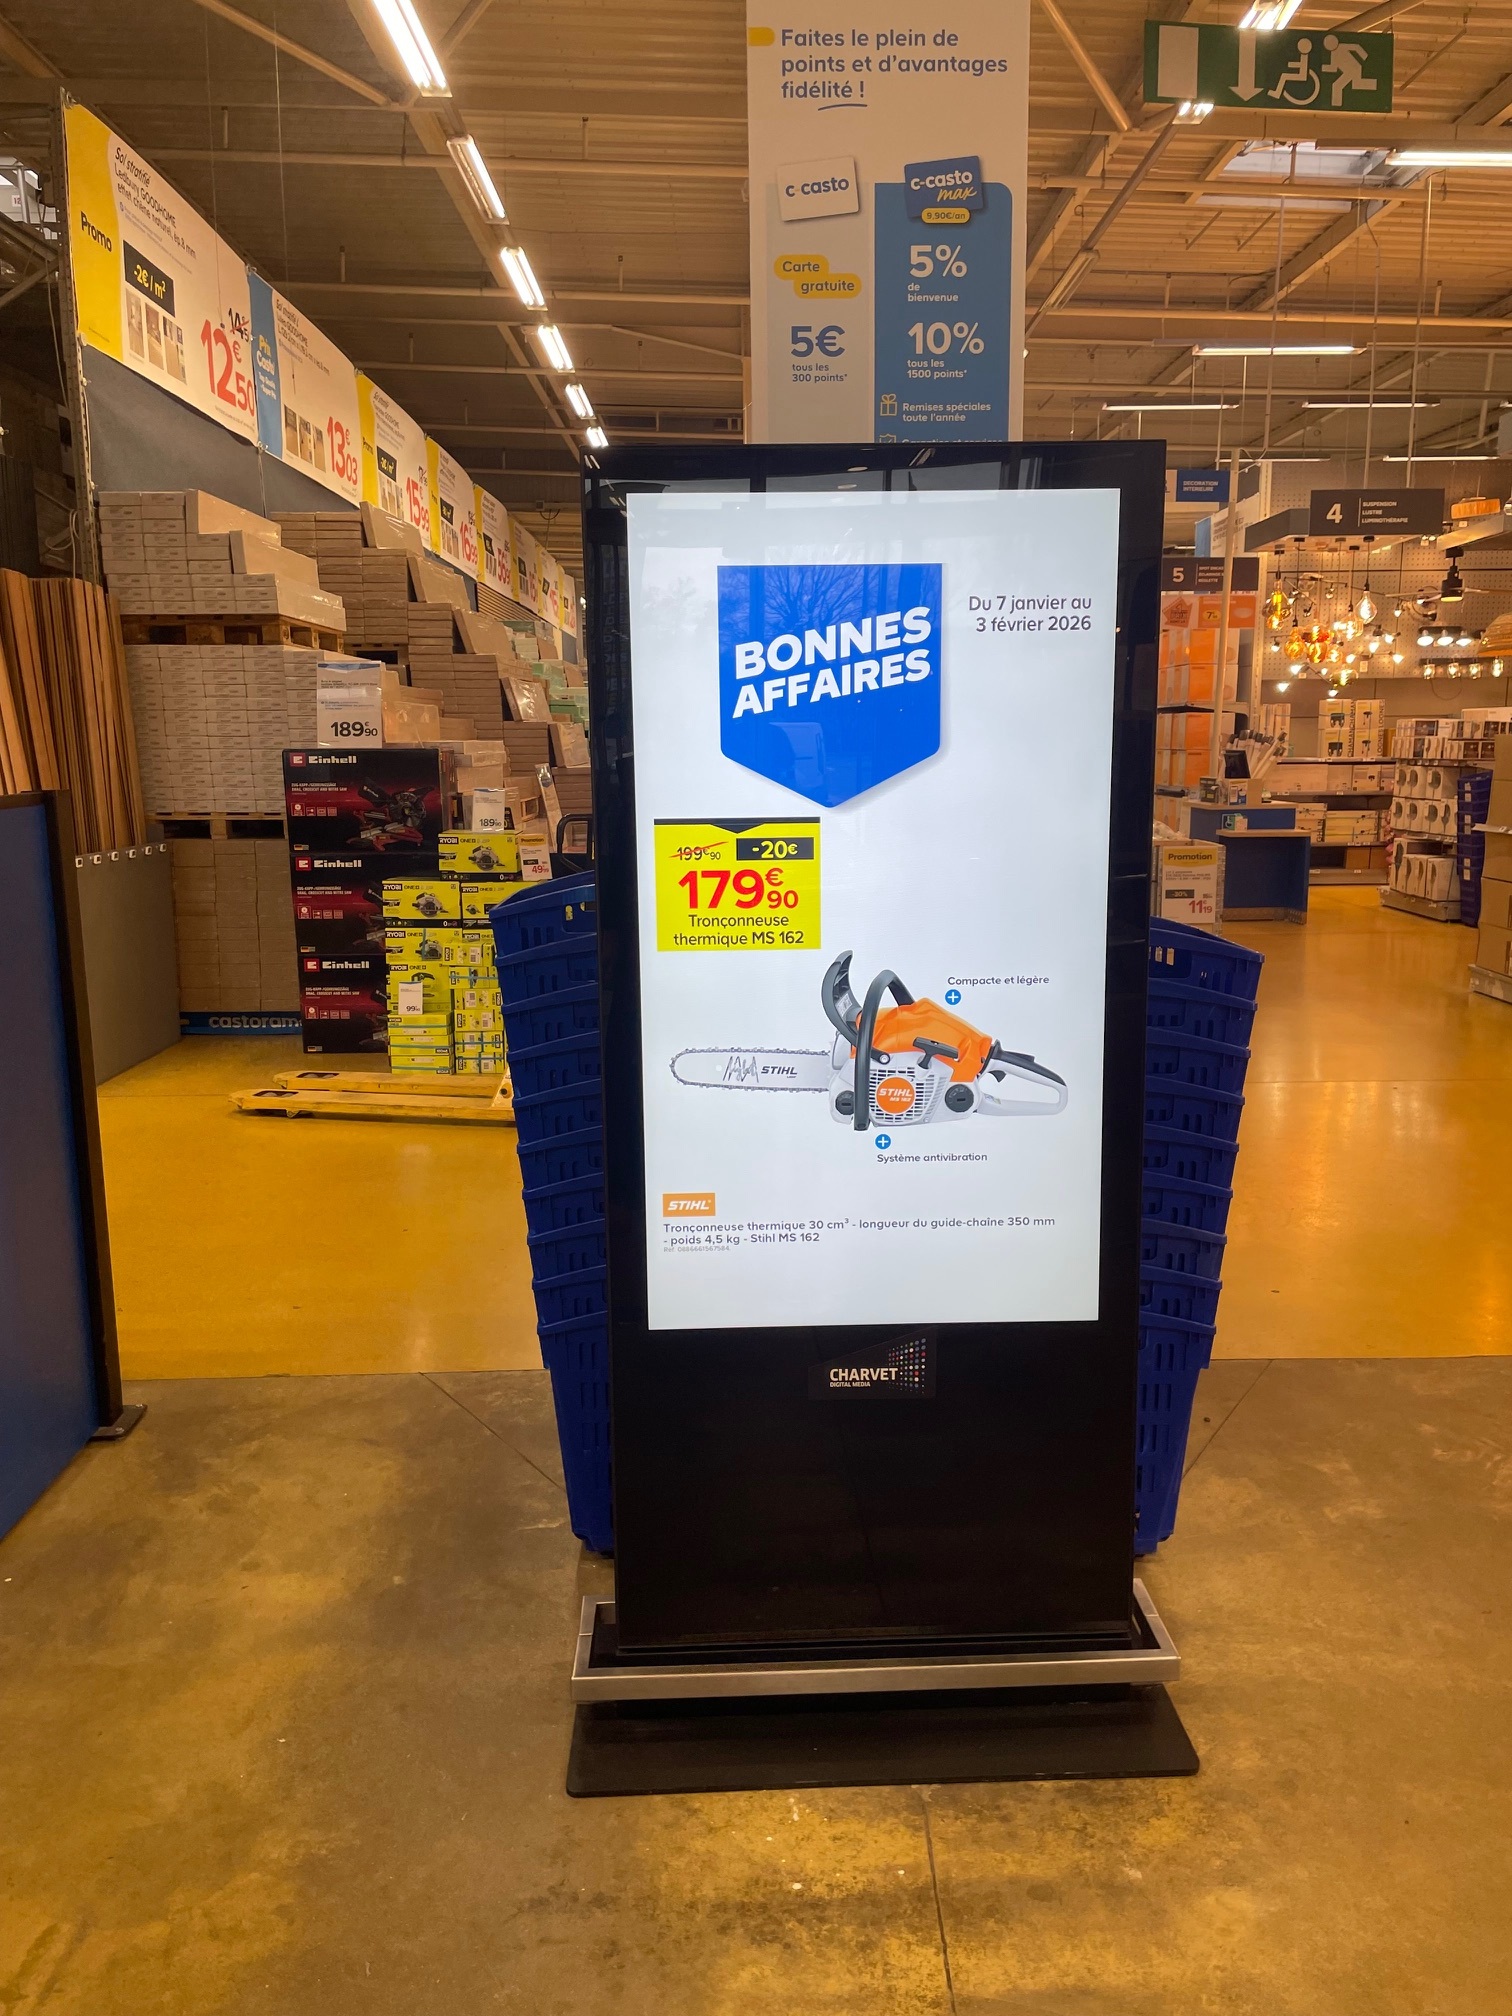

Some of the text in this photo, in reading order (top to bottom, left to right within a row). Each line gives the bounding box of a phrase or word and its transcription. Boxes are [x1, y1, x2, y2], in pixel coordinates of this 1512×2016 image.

[781, 29, 959, 51] Faites le plein de
[781, 55, 846, 77] points
[852, 56, 872, 73] et
[781, 80, 865, 98] fidélité !
[115, 147, 127, 164] Sol
[126, 159, 151, 188] stratifié
[910, 170, 973, 191] c-casto
[117, 182, 133, 202] effet
[133, 195, 151, 219] chêne
[936, 186, 978, 202] max
[140, 187, 177, 229] GOODHOME
[926, 212, 966, 221] 9,90€/an
[80, 211, 112, 252] Promo
[782, 261, 820, 273] Carte
[909, 244, 968, 278] 5%
[134, 264, 149, 288] -2€
[801, 279, 855, 295] gratuite
[908, 282, 920, 291] de
[907, 293, 959, 302] bienvenue
[790, 325, 846, 358] 5€
[907, 321, 985, 355] 10%
[792, 363, 830, 372] tous les
[907, 359, 945, 368] tous les
[792, 374, 812, 382] 300
[907, 370, 932, 378] 1500
[902, 402, 991, 413] Remises spéciales
[902, 413, 966, 422] toute l'année
[1326, 503, 1343, 524] 4
[1172, 567, 1185, 583] 5
[969, 594, 1092, 614] Du 7 janvier au
[976, 615, 1092, 632] 3 février 2026
[735, 606, 932, 680] BONNES
[732, 648, 931, 719] AFFAIRES
[308, 755, 357, 764] Einhell
[752, 840, 798, 859] -20€
[1168, 852, 1213, 861] Promotion
[313, 860, 362, 868] Einhell
[678, 867, 799, 909] 179€90
[688, 914, 789, 929] Tronçonneuse
[673, 930, 804, 947] thermique MS 162
[322, 960, 370, 969] Einhell
[947, 975, 1050, 987] Compacte et légère
[208, 1014, 303, 1028] castoram
[761, 1066, 798, 1075] STIHL
[879, 1088, 913, 1097] STIHL
[877, 1153, 988, 1165] Système antivibration
[663, 1223, 745, 1234] Tronçonneuse
[747, 1221, 806, 1232] thermique
[809, 1221, 824, 1230] 30
[827, 1218, 850, 1229] cm³
[859, 1219, 910, 1230] longueur
[912, 1219, 928, 1228] du
[930, 1217, 1004, 1229] guide-chaîne
[1007, 1217, 1030, 1226] 350
[1033, 1217, 1055, 1226] mm
[670, 1235, 702, 1246] poids
[704, 1234, 723, 1246] 4,5
[726, 1234, 740, 1246] kg
[750, 1233, 776, 1243] Stihl
[778, 1233, 797, 1243] MS
[800, 1233, 820, 1242] 162
[829, 1367, 898, 1381] CHARVET
